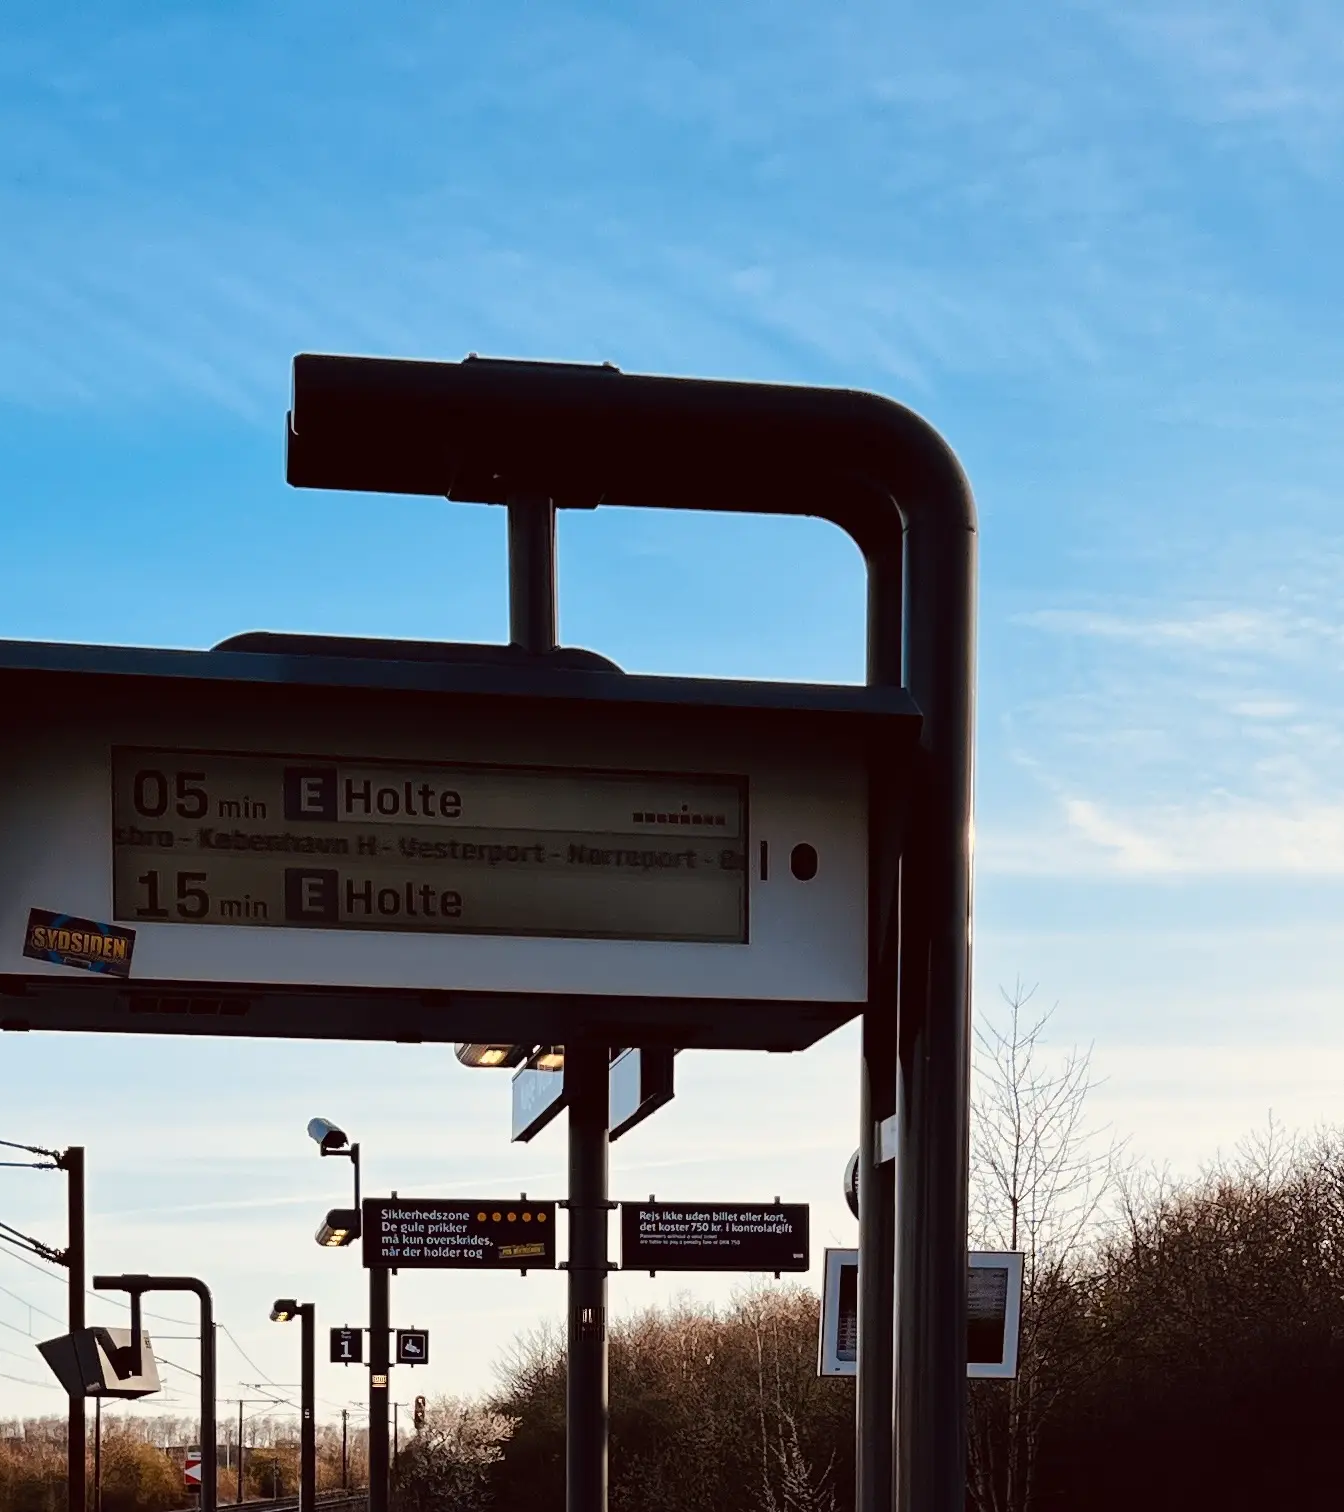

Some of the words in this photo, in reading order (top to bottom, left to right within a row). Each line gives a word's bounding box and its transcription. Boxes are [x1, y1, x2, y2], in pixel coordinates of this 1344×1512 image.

[133, 769, 209, 819] 05
[218, 795, 267, 819] min
[299, 777, 325, 813] E
[345, 778, 462, 818] Holte
[357, 834, 377, 855] H
[136, 869, 210, 919] 15
[220, 895, 268, 919] min
[300, 877, 326, 913] E
[345, 880, 462, 918] Holte
[33, 926, 127, 960] SYDSIDEN
[381, 1208, 470, 1221] Sikkerhedszone
[639, 1211, 660, 1222] Rejs
[662, 1211, 683, 1221] ikke
[685, 1211, 711, 1221] uden
[712, 1212, 738, 1222] billet
[739, 1212, 762, 1222] eller
[763, 1212, 787, 1223] kort,
[381, 1222, 398, 1232] De
[400, 1222, 425, 1235] gule
[427, 1222, 468, 1235] prikker
[639, 1222, 656, 1232] det
[658, 1222, 689, 1232] koster
[690, 1222, 709, 1232] 750
[711, 1223, 723, 1232] kr.
[731, 1223, 793, 1234] kontrolafgift
[381, 1233, 400, 1244] må
[402, 1235, 424, 1245] kun
[426, 1235, 494, 1247] overskrides,
[381, 1245, 401, 1257] når
[402, 1246, 421, 1257] der
[424, 1246, 462, 1258] holder
[463, 1248, 483, 1259] tog
[340, 1340, 353, 1358] 1
